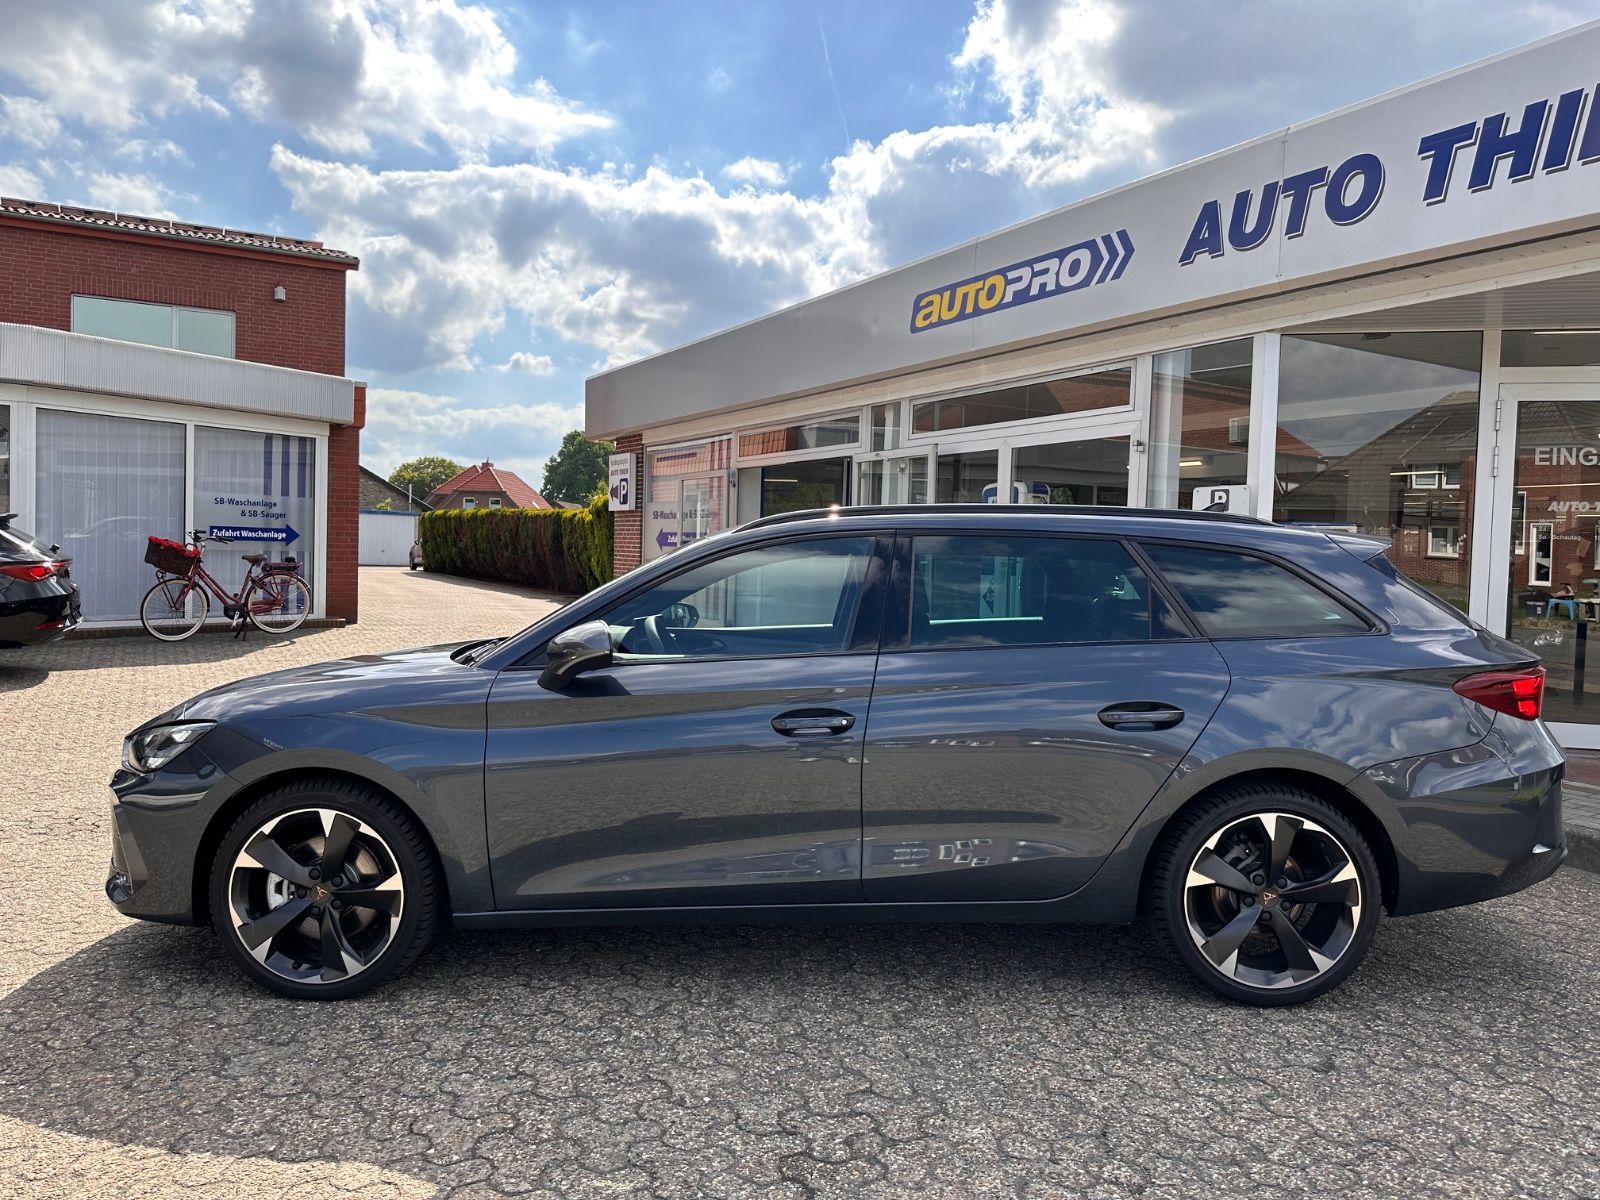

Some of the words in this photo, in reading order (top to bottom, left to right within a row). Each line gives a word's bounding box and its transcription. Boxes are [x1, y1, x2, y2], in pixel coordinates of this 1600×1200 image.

[1178, 153, 1386, 267] AUTO
[1417, 82, 1600, 208] THI
[1534, 446, 1600, 466] EING
[214, 497, 277, 509] SB-Waschanlage
[1547, 501, 1590, 513] AUTO
[240, 509, 246, 517] &
[248, 510, 287, 520] SB-Sauger
[212, 528, 240, 537] Zufahrt
[241, 530, 287, 540] Waschanlage
